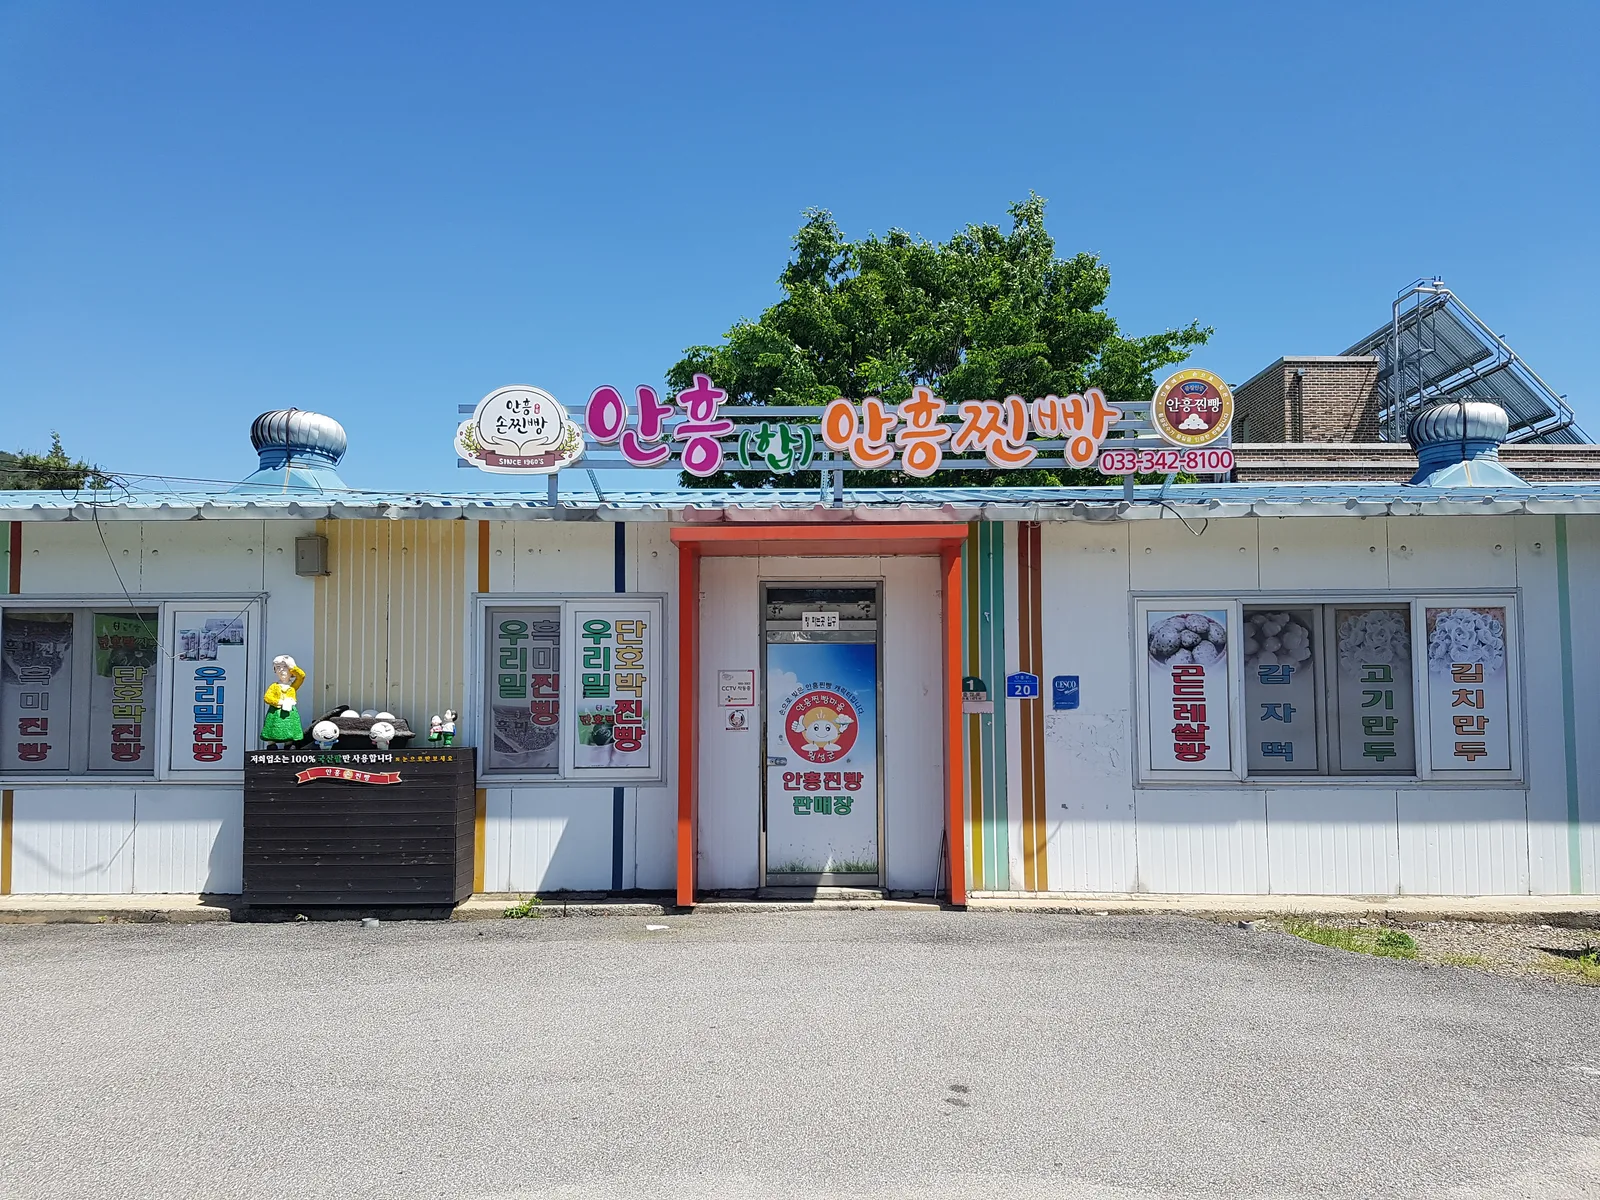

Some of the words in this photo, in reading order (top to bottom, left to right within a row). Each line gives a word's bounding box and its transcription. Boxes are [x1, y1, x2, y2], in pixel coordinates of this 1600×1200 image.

[506, 398, 531, 415] 안흥
[1166, 397, 1222, 412] 안흥찐빵
[496, 415, 548, 435] 손찐빵
[585, 373, 735, 477] 안흥
[822, 385, 1123, 477] 안흥찐빵
[498, 458, 522, 466] SINCE
[523, 458, 544, 466] 1960'S
[1102, 450, 1233, 471] 033-342-8100
[499, 619, 529, 699] 우리밀
[582, 619, 612, 699] 우리밀
[966, 679, 974, 691] 1
[1014, 684, 1031, 695] 20
[1055, 680, 1076, 689] CESCO
[779, 697, 793, 716] 손으로
[791, 686, 804, 698] 빚은
[805, 681, 833, 691] 안흥찐빵
[795, 695, 845, 712] 안흥찐빵마을
[1171, 665, 1210, 762] 곤드레쌀빵
[1258, 664, 1296, 762] 감자떡
[1360, 664, 1398, 762] 고기만두
[1451, 663, 1490, 762] 김치만두
[250, 754, 290, 764] 저희업소는
[291, 754, 316, 764] 100%
[352, 753, 393, 763] 사용합니다
[808, 751, 835, 762] 횡성군
[782, 771, 864, 791] 안흥찐빵
[793, 795, 854, 816] 판매장
